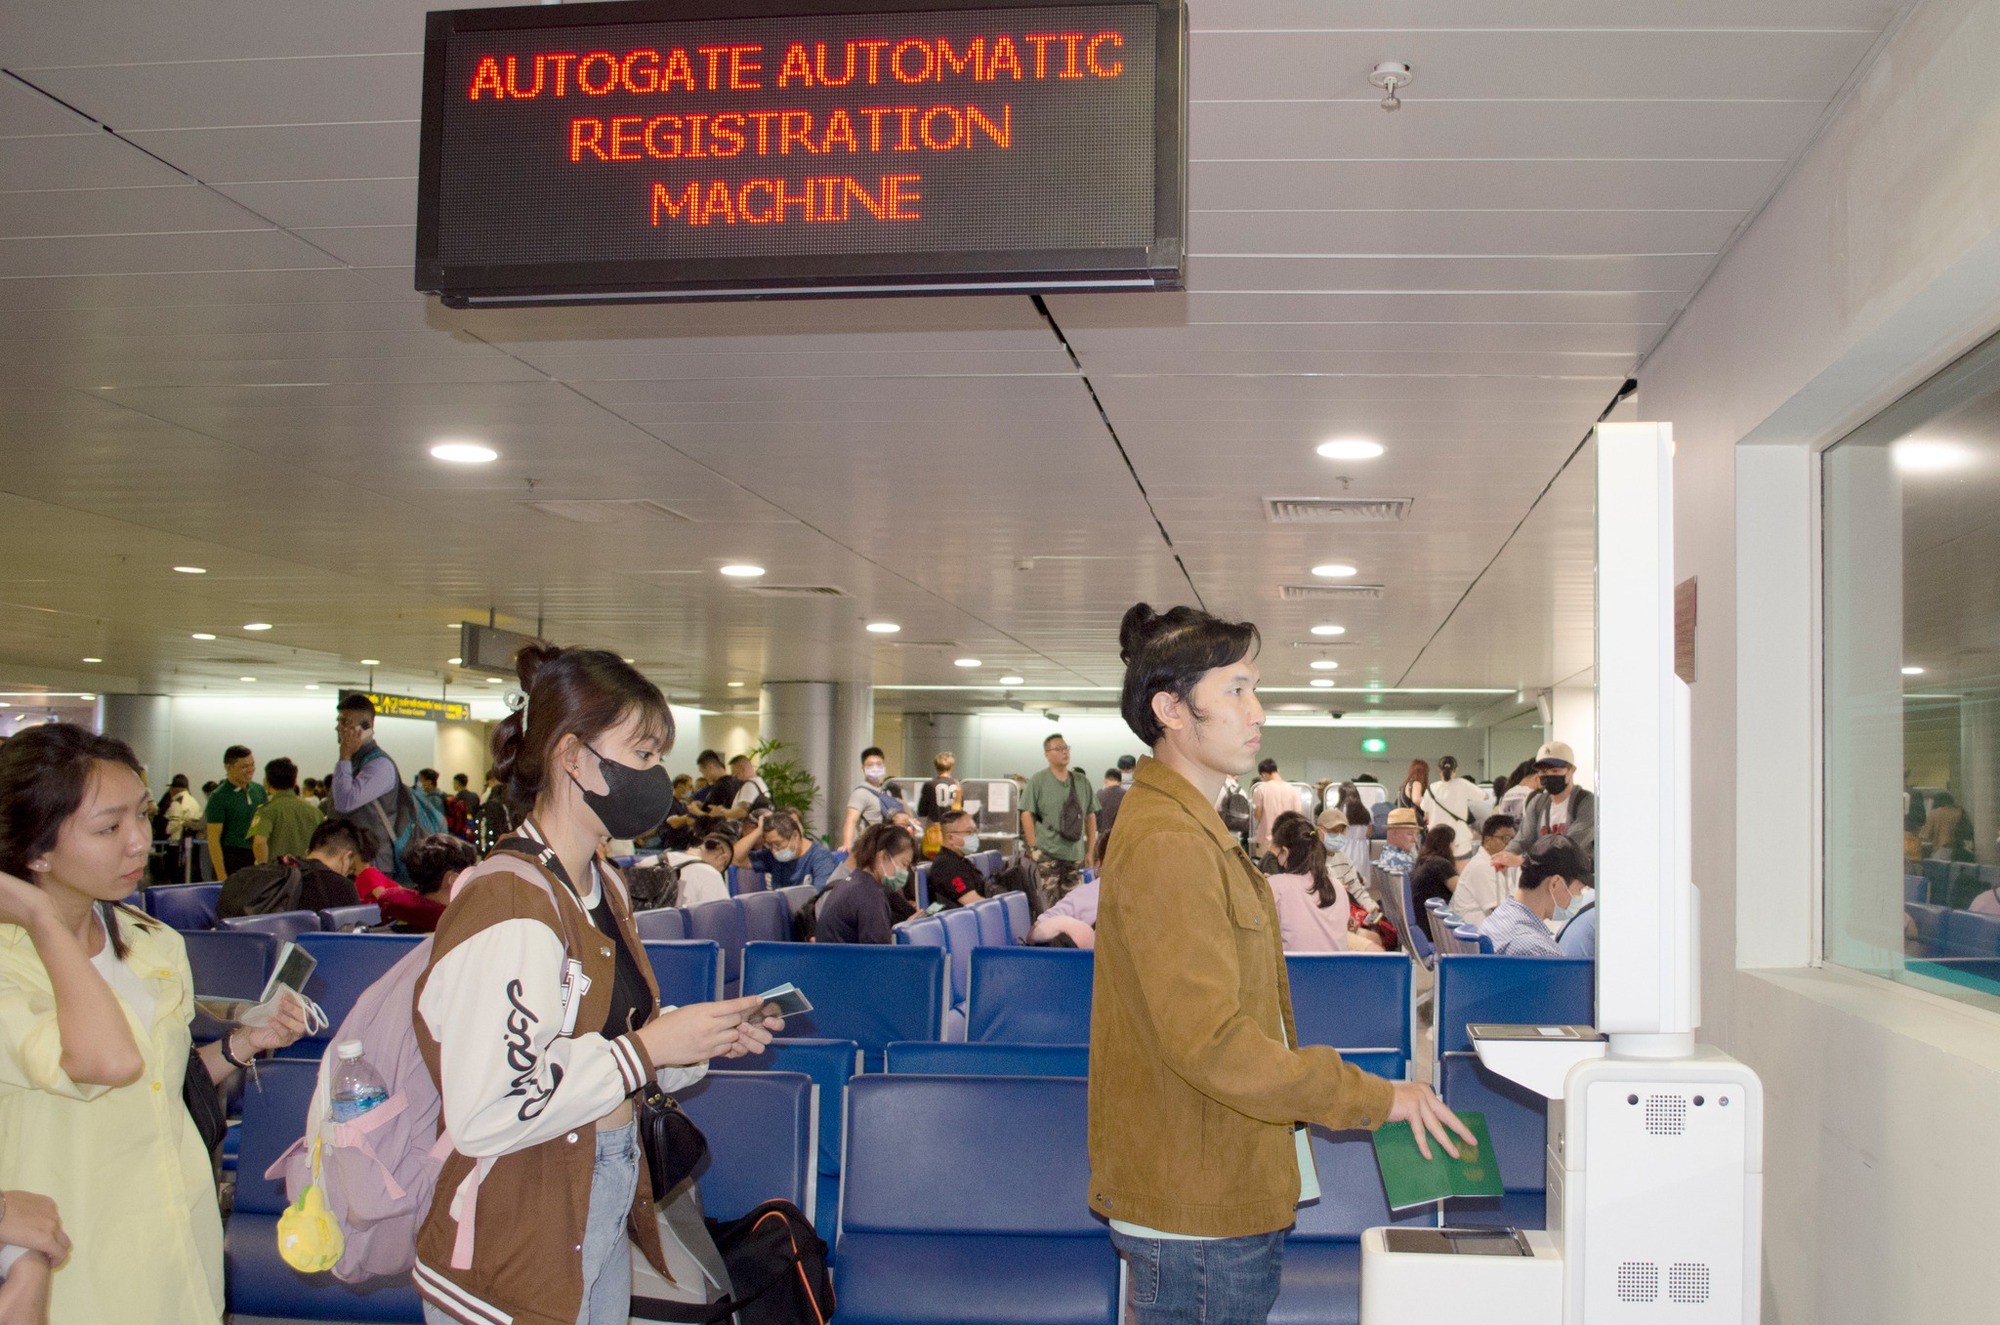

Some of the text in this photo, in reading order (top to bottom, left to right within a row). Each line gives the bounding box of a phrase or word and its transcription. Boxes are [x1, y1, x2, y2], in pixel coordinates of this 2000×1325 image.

[470, 32, 1124, 100] AUTOGATE AUTOMATIC
[570, 103, 1011, 161] REGISTRATION
[652, 174, 922, 226] MACHINE
